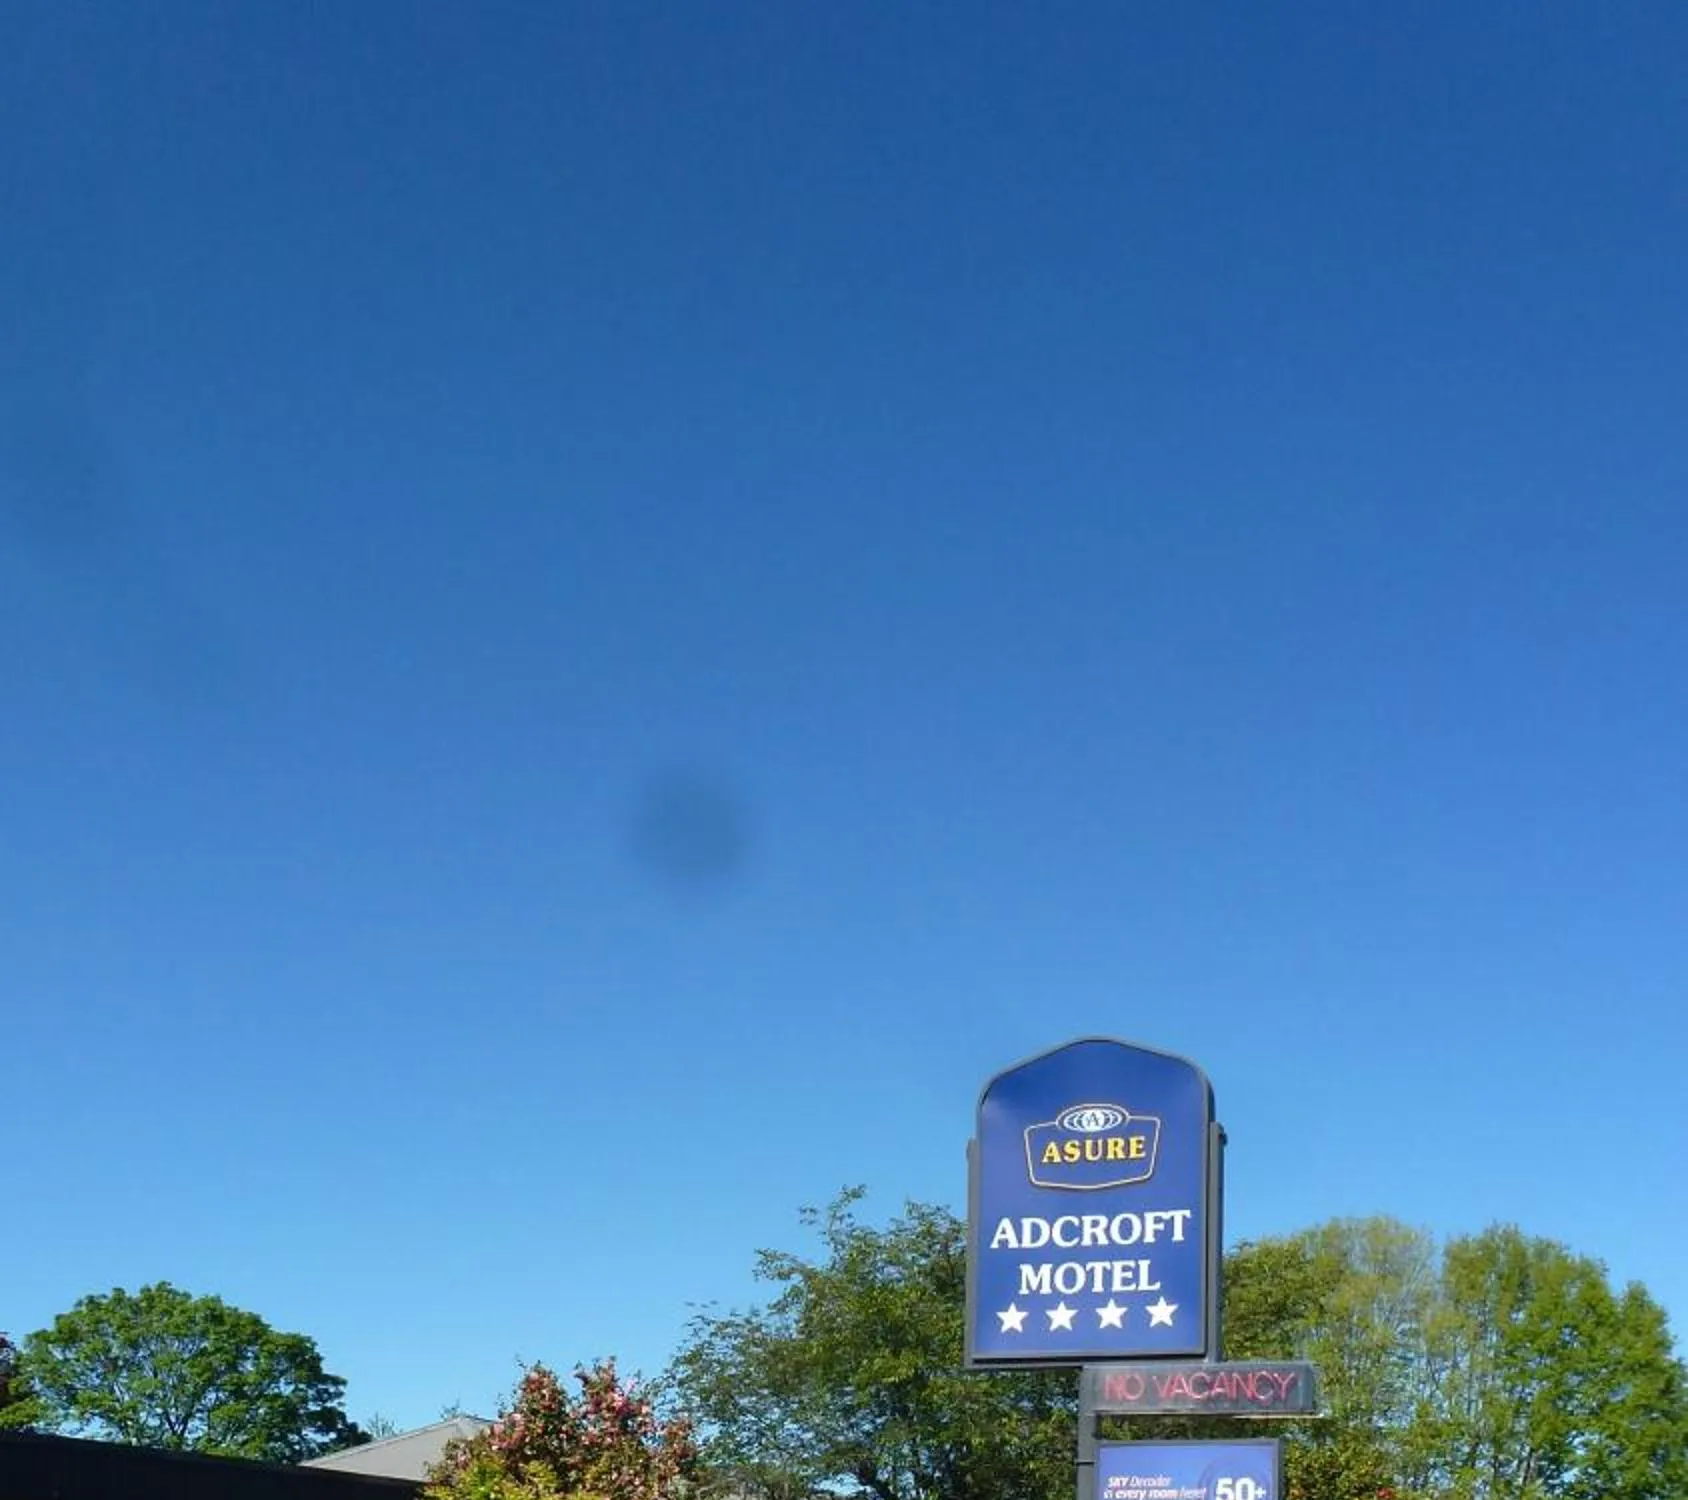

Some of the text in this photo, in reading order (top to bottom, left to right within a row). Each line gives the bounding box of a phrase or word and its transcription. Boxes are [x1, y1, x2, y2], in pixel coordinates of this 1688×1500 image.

[1042, 1136, 1147, 1163] ASURE
[990, 1210, 1191, 1248] ADCROFT
[1019, 1260, 1161, 1294] MOTEL
[1105, 1370, 1295, 1402] NO VACANCY
[1115, 1489, 1147, 1500] every
[1148, 1489, 1178, 1499] room
